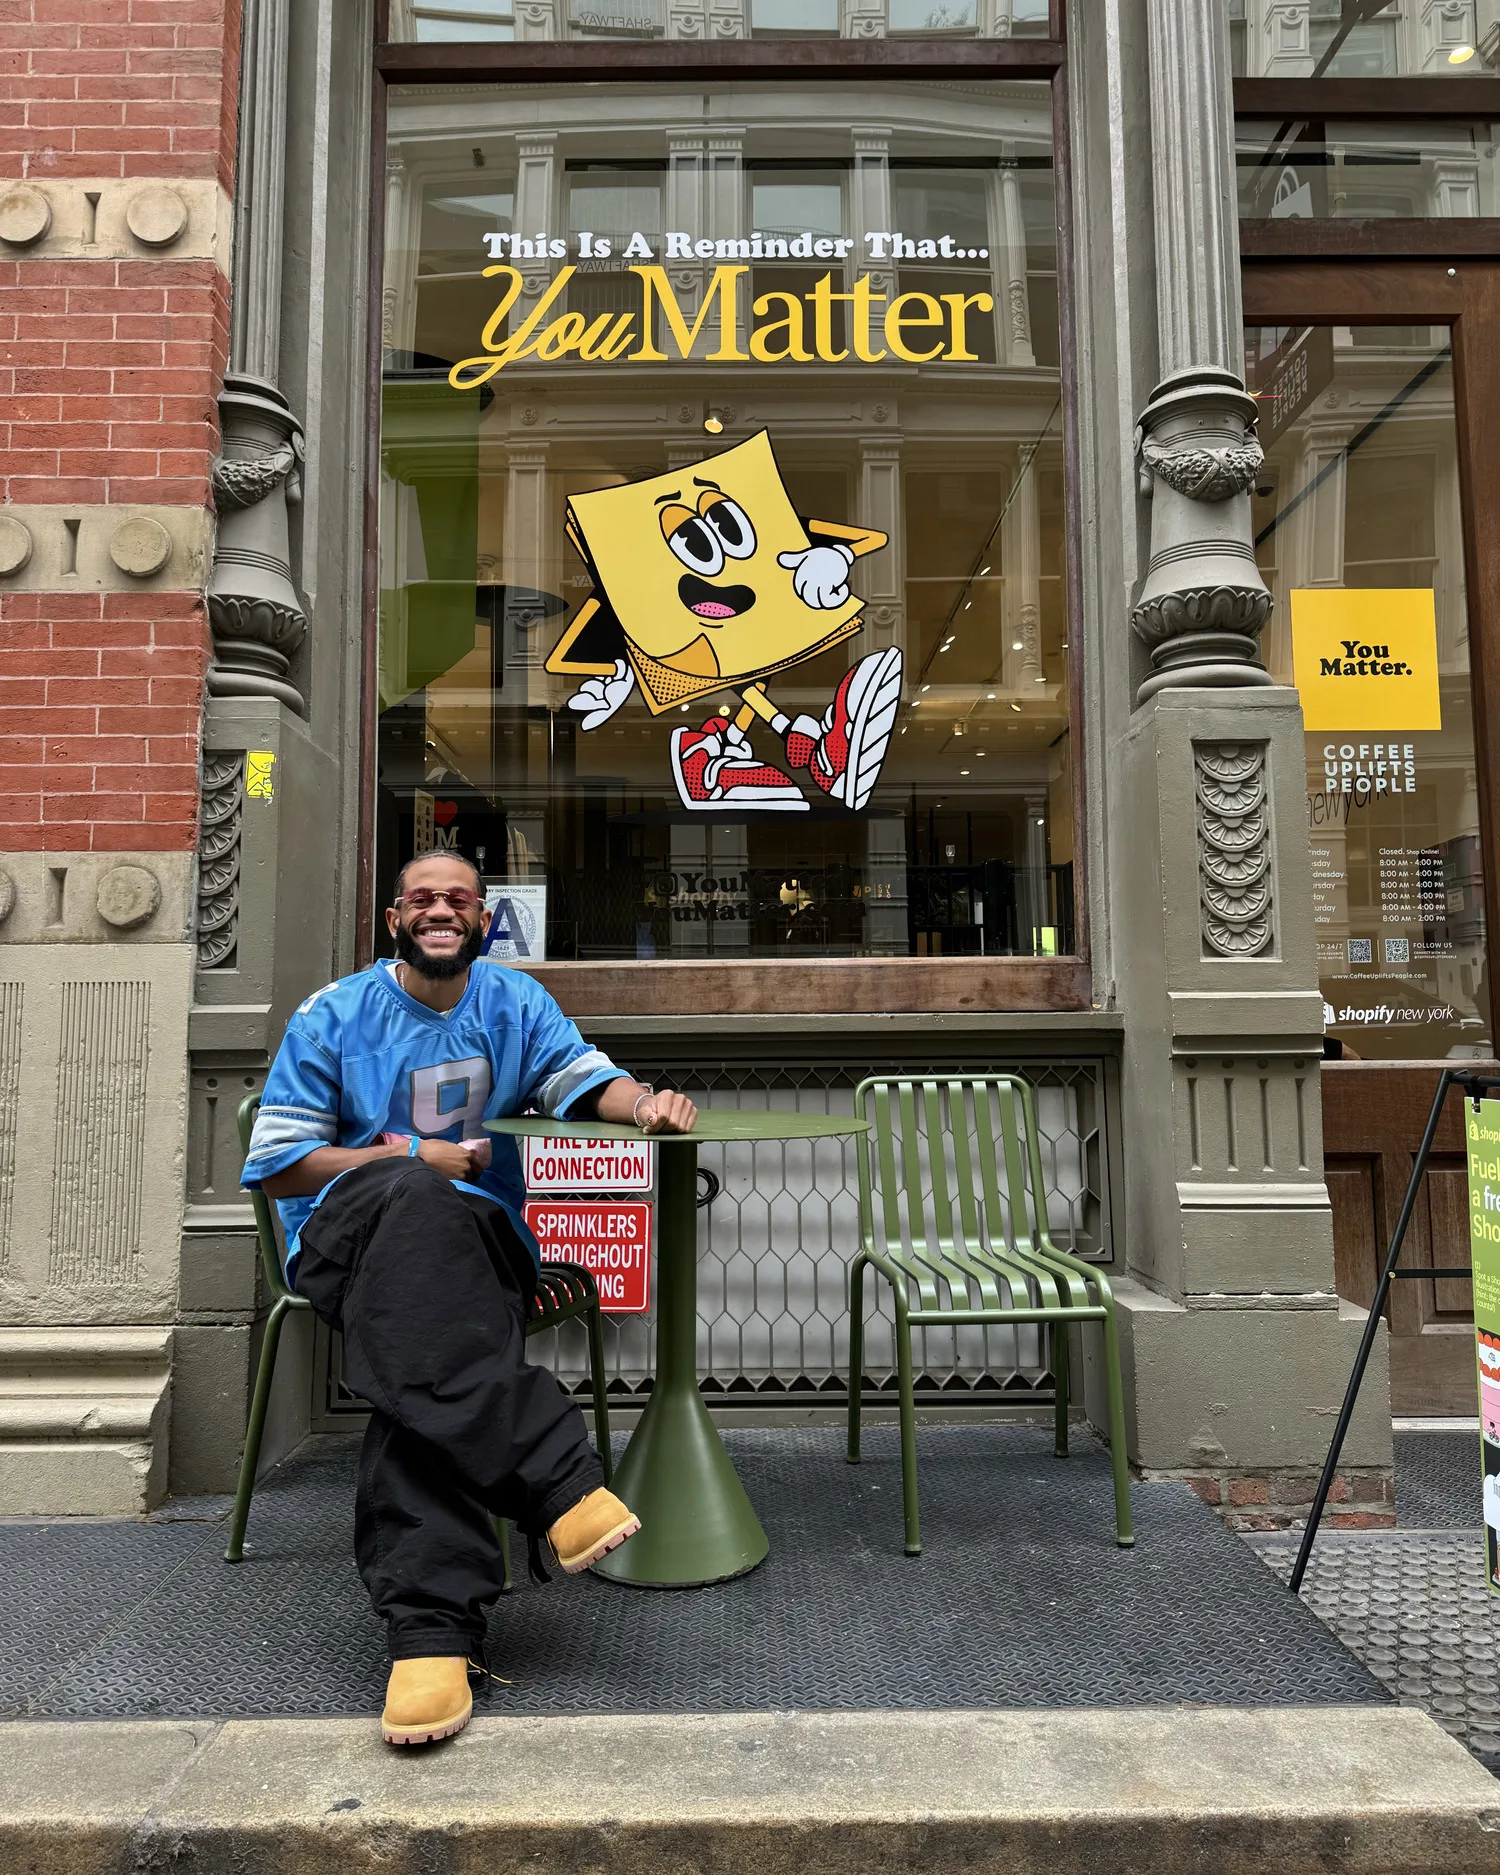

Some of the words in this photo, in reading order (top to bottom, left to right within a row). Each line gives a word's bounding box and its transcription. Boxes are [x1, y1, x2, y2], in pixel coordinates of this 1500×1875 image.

[482, 231, 567, 259] This
[577, 231, 611, 259] Is
[622, 231, 655, 259] A
[665, 231, 854, 260] Reminder
[864, 231, 990, 259] That...
[1340, 640, 1390, 659] You
[1319, 658, 1413, 676] Matter.
[1323, 744, 1415, 760] COFFEE
[1324, 760, 1416, 777] UPLIFTS
[1326, 777, 1416, 793] PEOPLE
[1312, 849, 1330, 857] nday
[1378, 848, 1405, 856] Closed.
[1406, 849, 1420, 857] Shop
[1312, 860, 1331, 868] sday
[1379, 859, 1396, 867] 8:00
[1414, 859, 1431, 867] 4:00
[1433, 859, 1443, 867] PM
[1312, 871, 1344, 879] dnesday
[1314, 904, 1336, 912] urday
[480, 897, 531, 957] A
[1332, 972, 1427, 980] www.CoffeeUpliftsPeople.com
[1338, 1005, 1395, 1024] shopify
[1396, 1008, 1425, 1020] new
[1426, 1004, 1454, 1023] york
[410, 1056, 491, 1142] 9
[532, 1157, 644, 1181] CONNECTION
[1472, 1189, 1481, 1208] a
[536, 1213, 638, 1239] SPRINKLERS
[540, 1244, 644, 1269] HROUGHOUT
